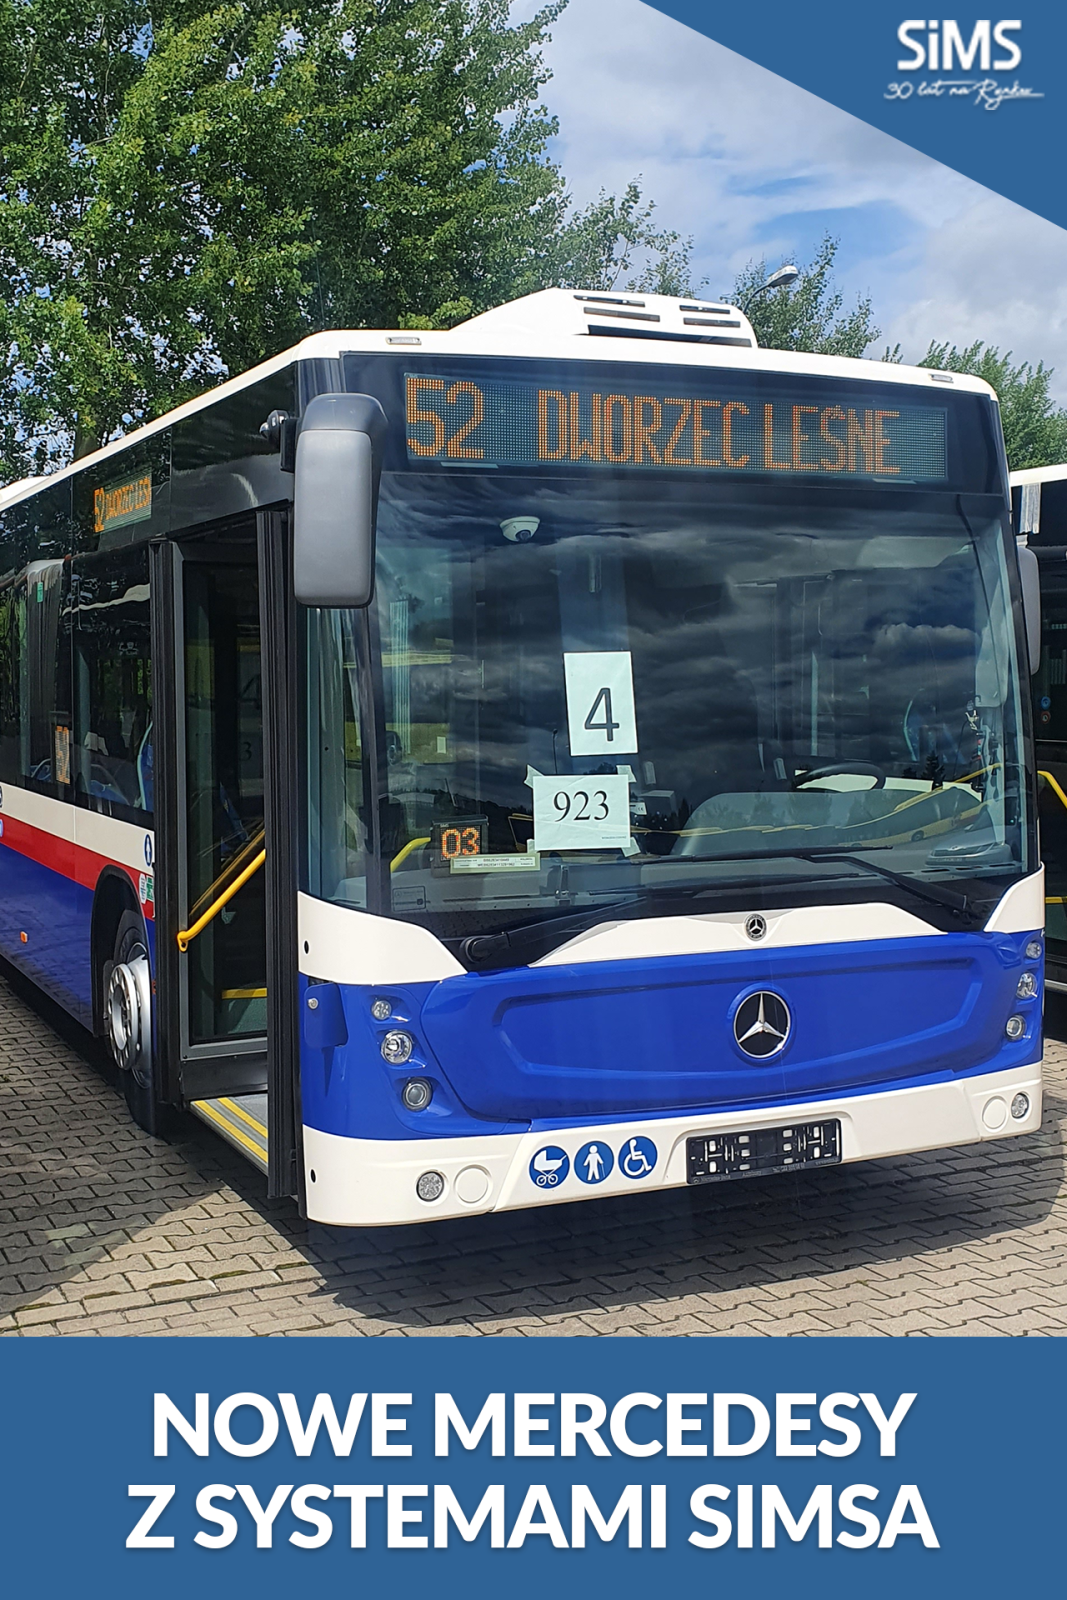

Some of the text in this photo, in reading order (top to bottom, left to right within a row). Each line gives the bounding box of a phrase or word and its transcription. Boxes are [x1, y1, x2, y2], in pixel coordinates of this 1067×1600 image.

[406, 377, 485, 459] 52
[538, 389, 750, 467] DWORZEC
[584, 687, 620, 742] 4
[553, 789, 610, 823] 923
[441, 827, 480, 859] 03
